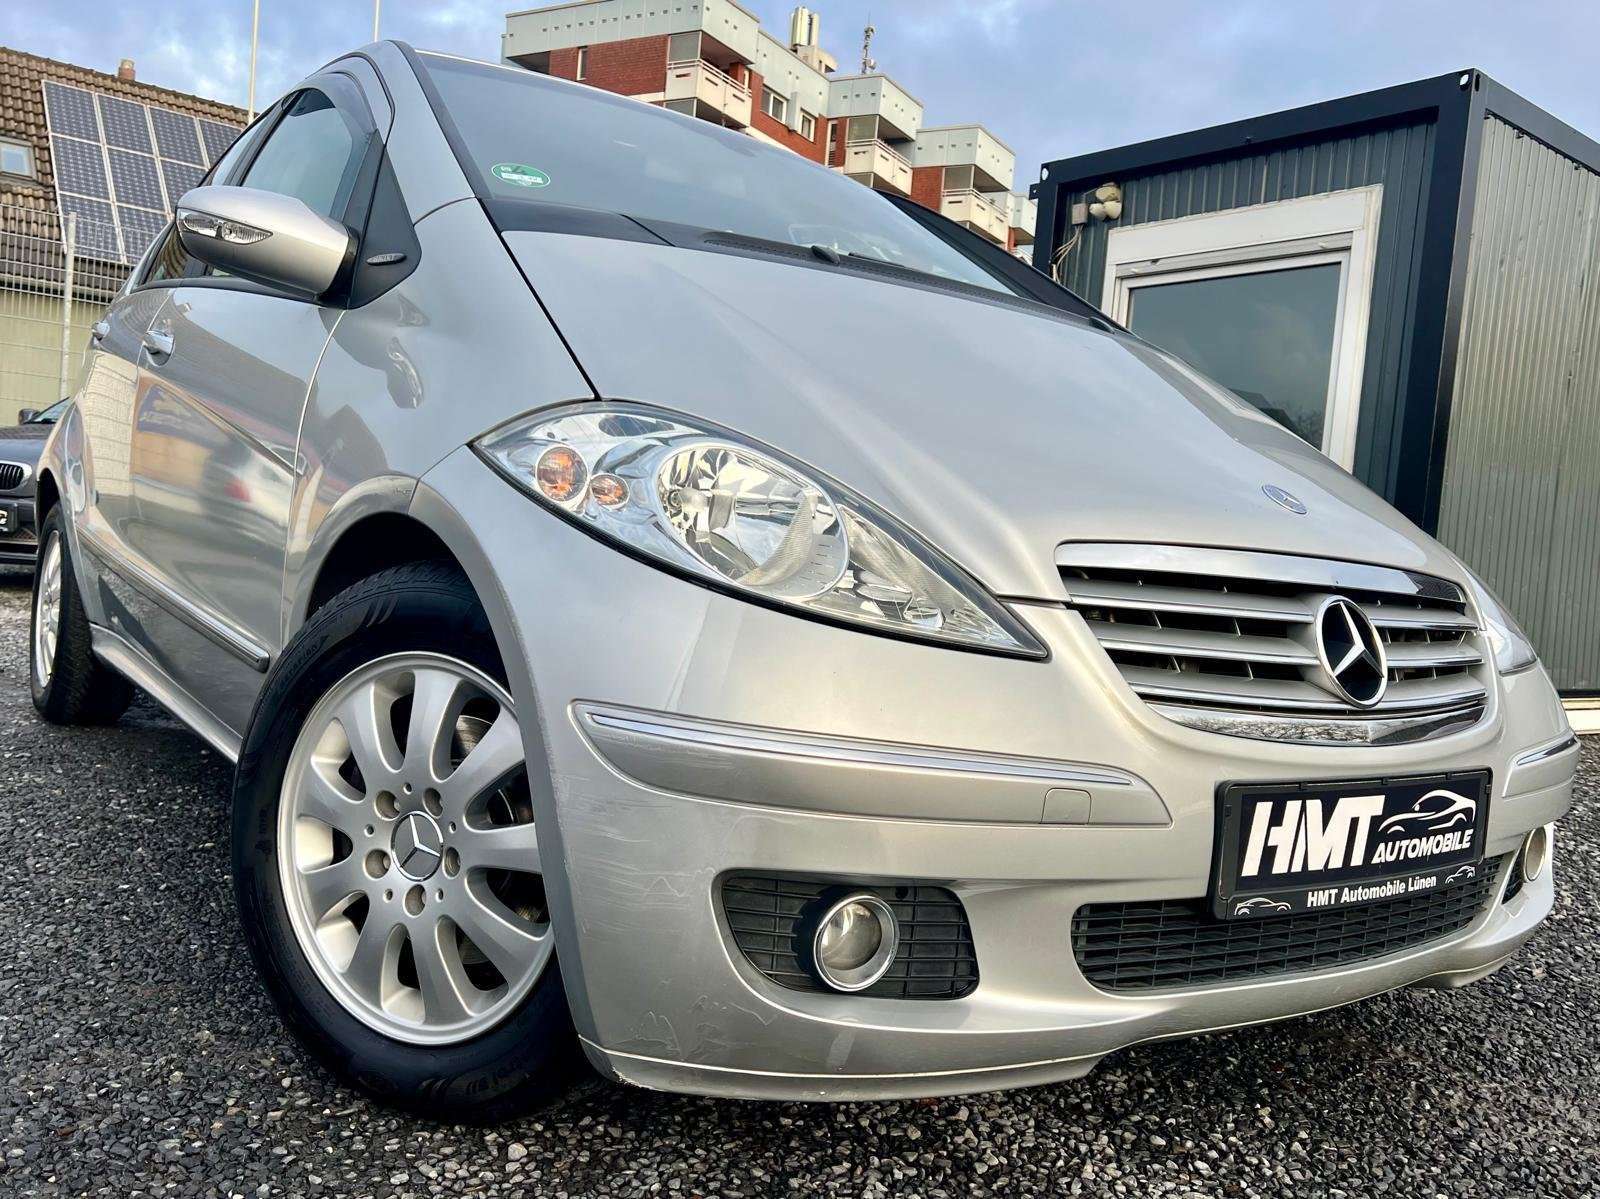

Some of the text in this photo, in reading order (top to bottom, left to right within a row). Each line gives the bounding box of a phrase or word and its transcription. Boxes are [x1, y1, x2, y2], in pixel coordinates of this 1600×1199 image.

[1241, 794, 1474, 877] HMT AUTOMOBILE
[1306, 875, 1437, 908] HMT Automobile Lünen
